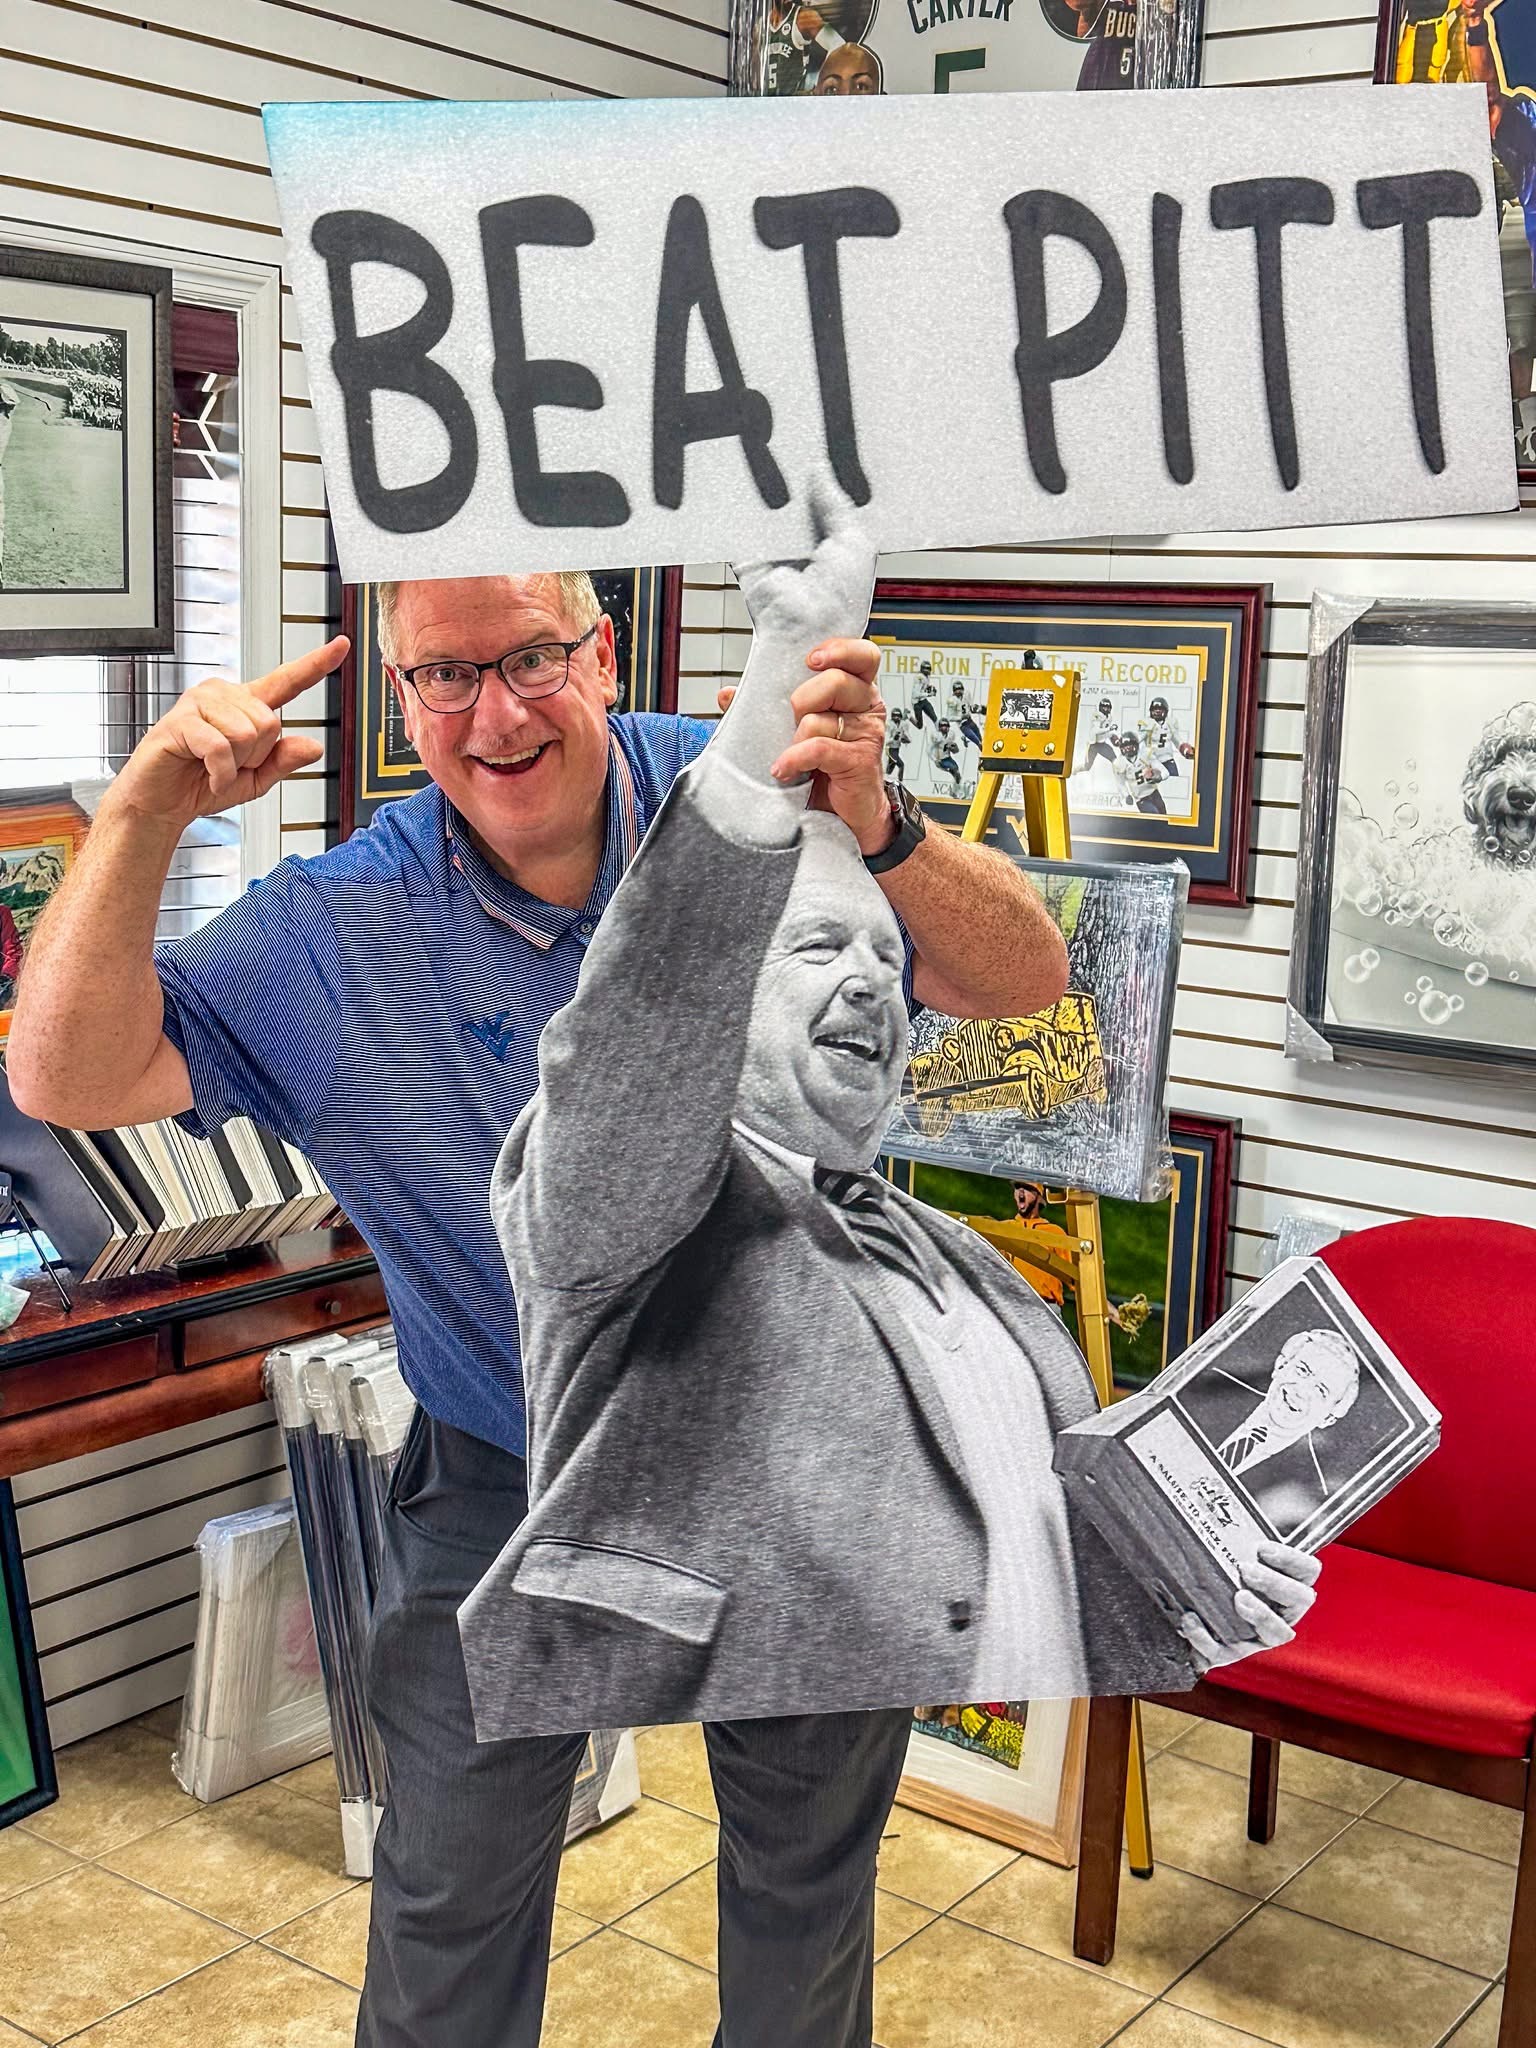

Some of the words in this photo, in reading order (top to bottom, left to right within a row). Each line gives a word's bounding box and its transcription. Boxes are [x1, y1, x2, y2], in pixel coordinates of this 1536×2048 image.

[1120, 47, 1133, 75] 5
[311, 186, 901, 534] BEAT
[1002, 169, 1482, 496] PITT
[931, 650, 970, 676] RUN
[1099, 656, 1188, 685] RECORD
[1158, 733, 1168, 748] 5
[1188, 1503, 1200, 1517] TO
